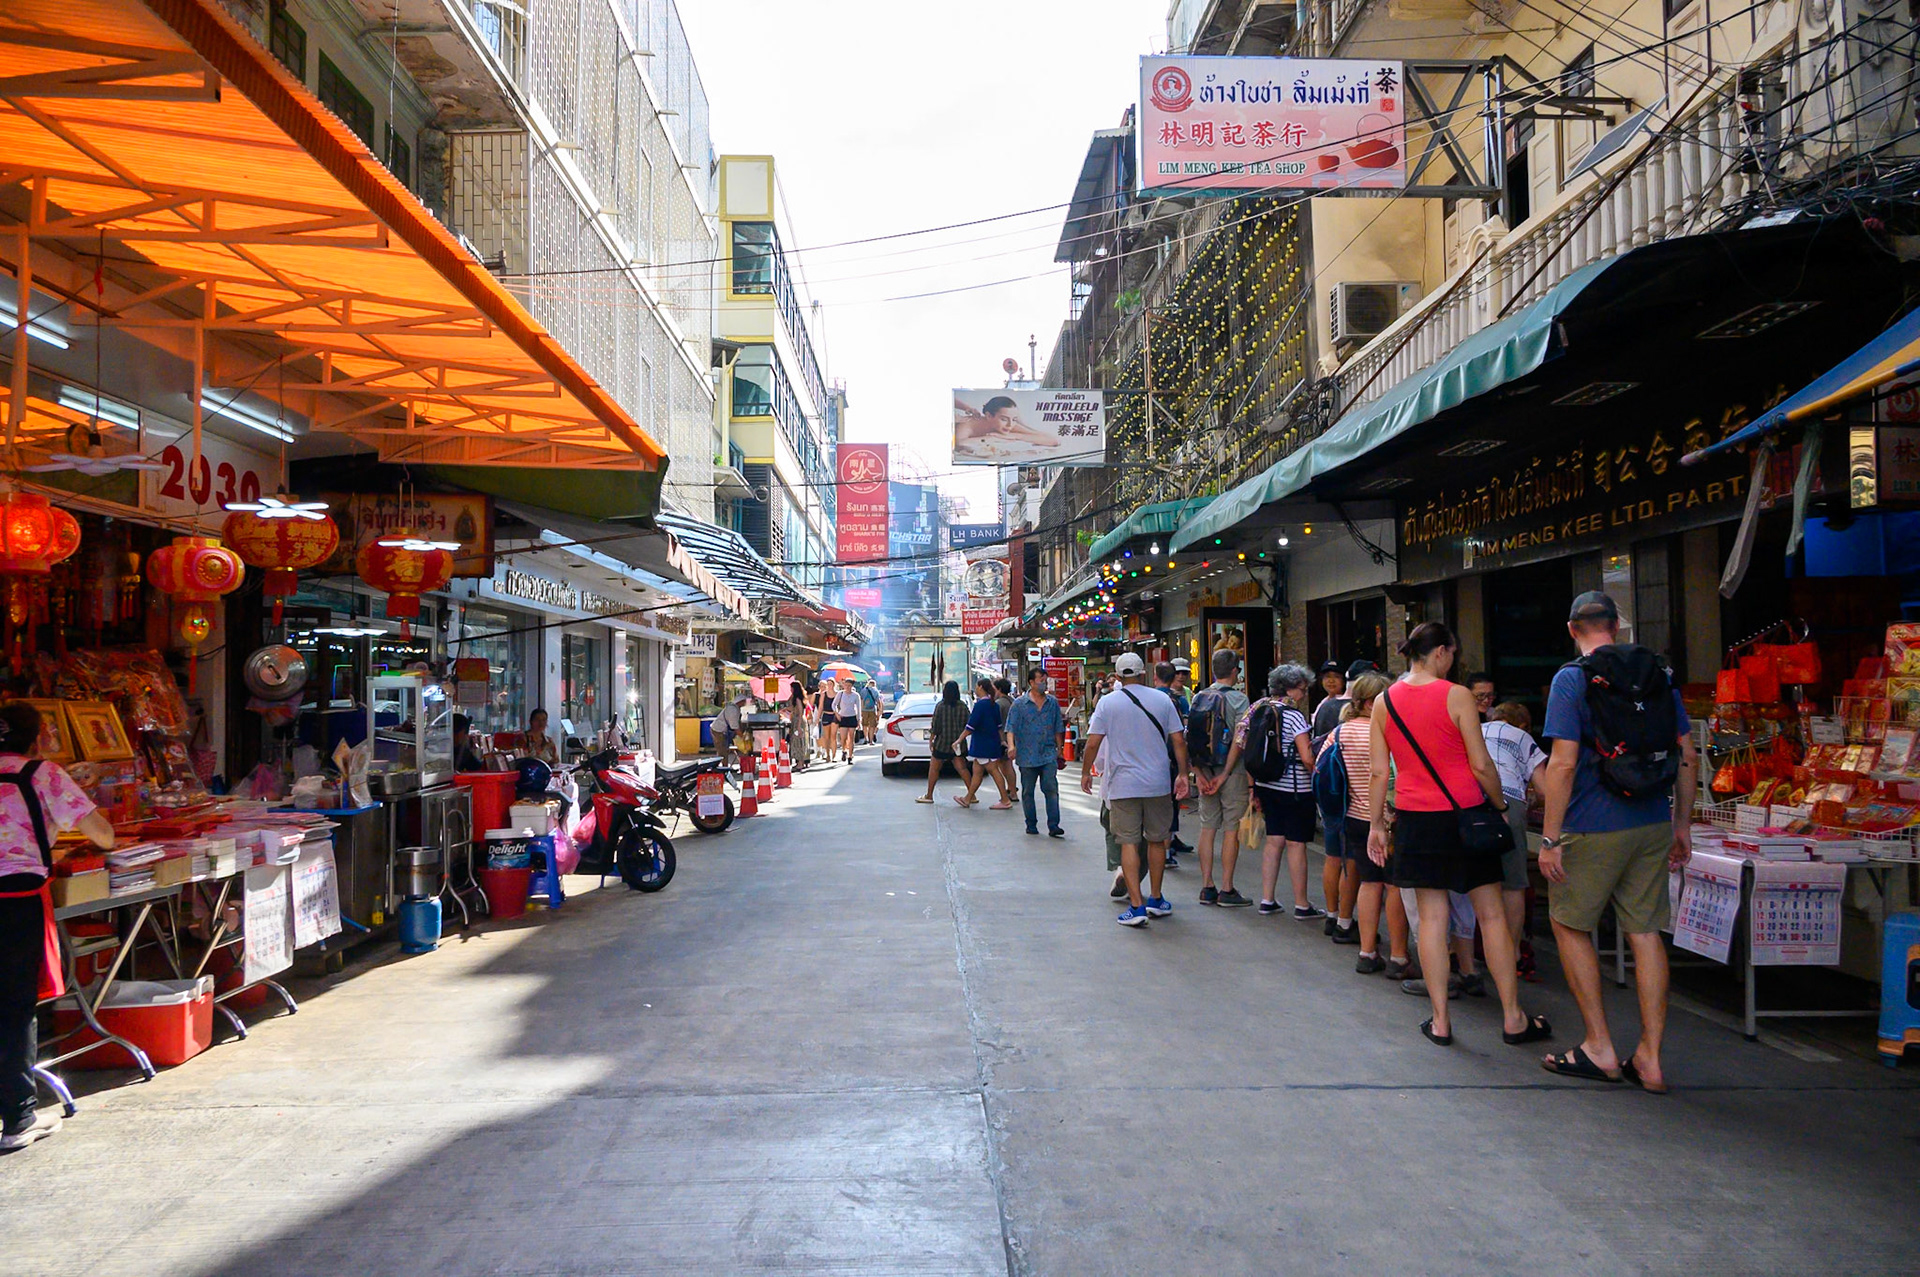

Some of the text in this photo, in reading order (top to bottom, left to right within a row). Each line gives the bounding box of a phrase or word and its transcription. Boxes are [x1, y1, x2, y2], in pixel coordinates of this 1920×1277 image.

[1375, 67, 1398, 94] 茶
[1159, 120, 1307, 147] 林明記茶行
[1159, 162, 1306, 174] LIM MENG KEE TEA SHOP
[1042, 412, 1093, 423] MASSAGE
[1058, 425, 1099, 437] 泰滿足
[160, 445, 260, 512] 2030
[1502, 525, 1555, 551] MENG
[1562, 513, 1603, 538] KEE
[1668, 475, 1745, 513] PART.
[952, 529, 1000, 538] LH BANK
[683, 634, 715, 651] าหมู
[489, 843, 527, 856] Delight
